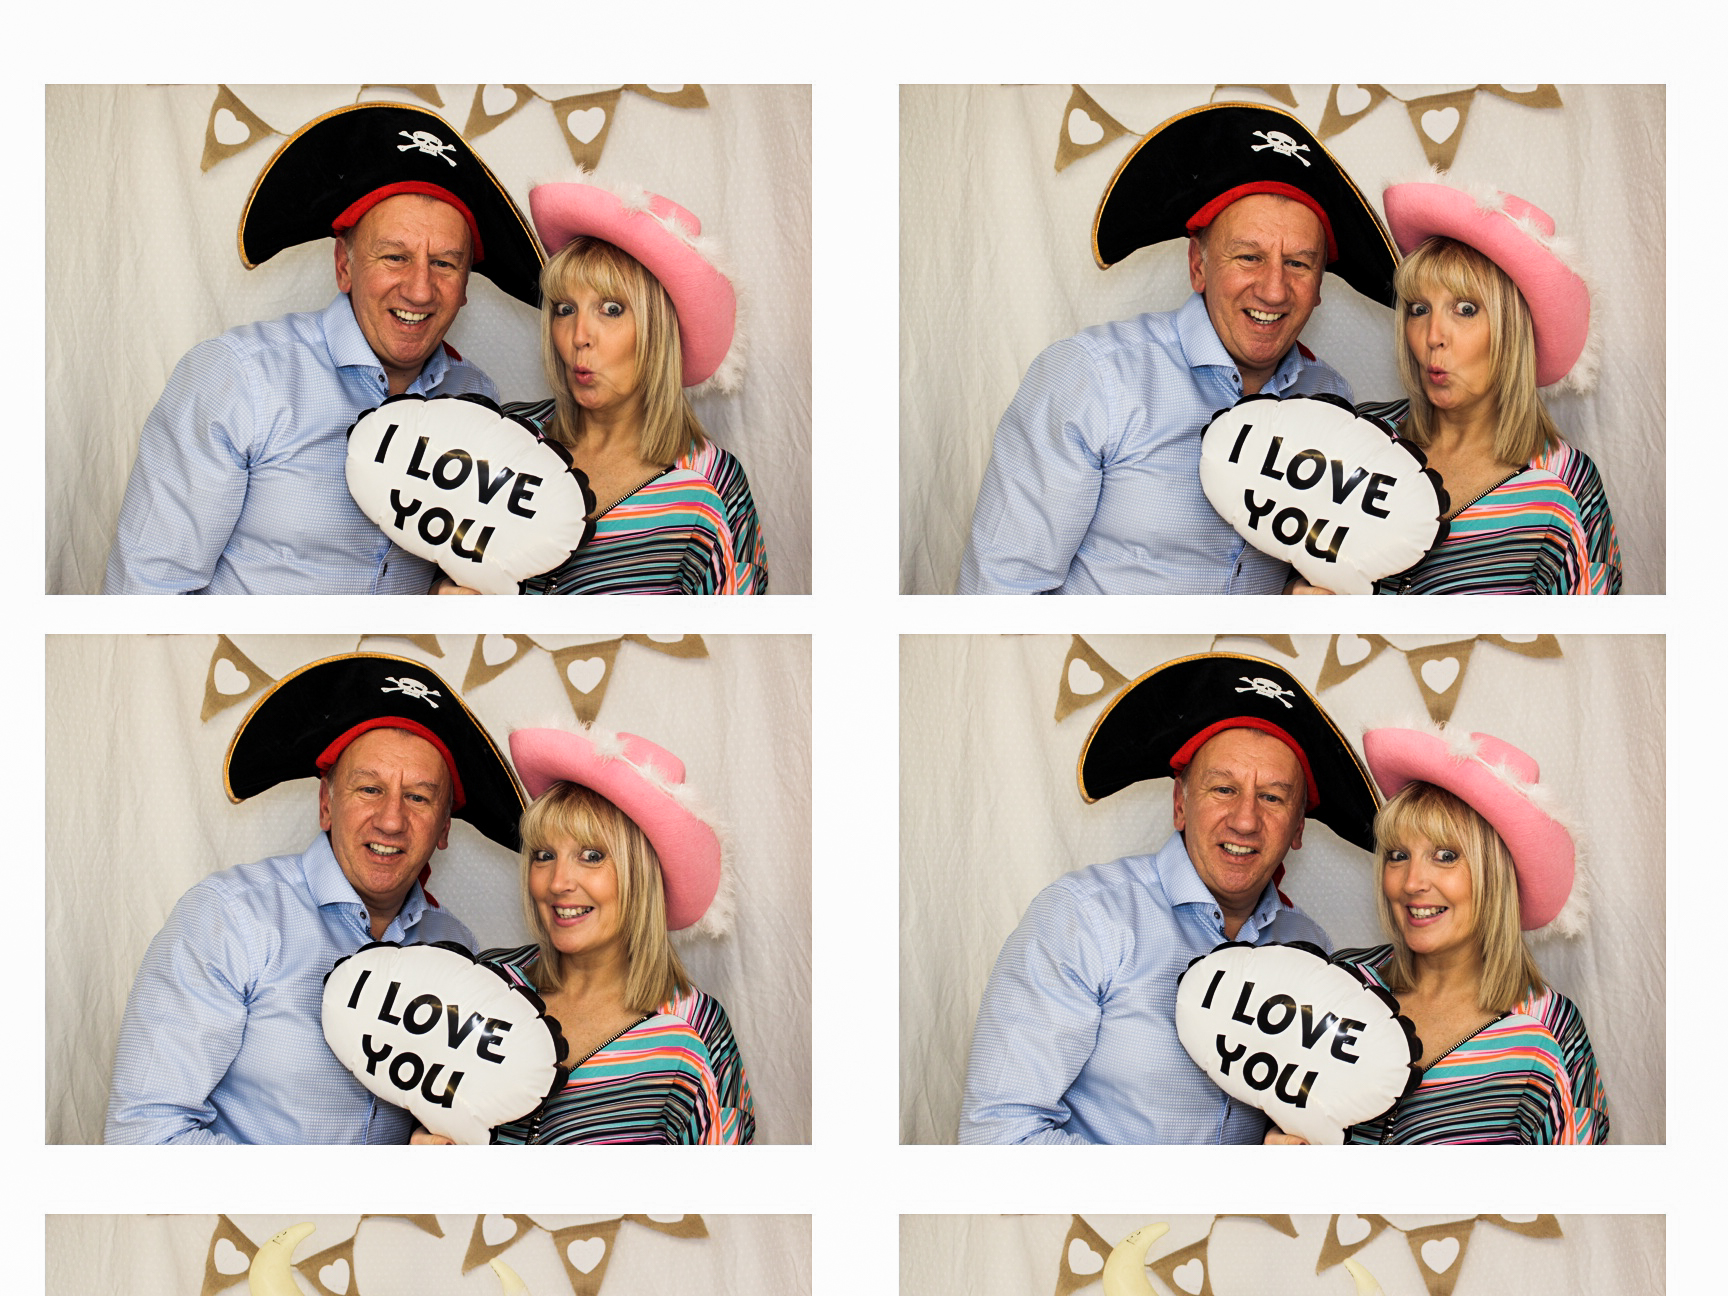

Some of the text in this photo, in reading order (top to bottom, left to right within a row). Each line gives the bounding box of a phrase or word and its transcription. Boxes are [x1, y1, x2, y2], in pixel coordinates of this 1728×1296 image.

[374, 423, 545, 520] I LOVE
[1228, 423, 1399, 520] I LOVE
[389, 488, 496, 564] YOU
[1243, 488, 1350, 564] YOU
[346, 969, 514, 1065] I LOVE
[1200, 969, 1368, 1065] I LOVE
[361, 1033, 466, 1109] YOU
[1215, 1033, 1320, 1109] YOU
